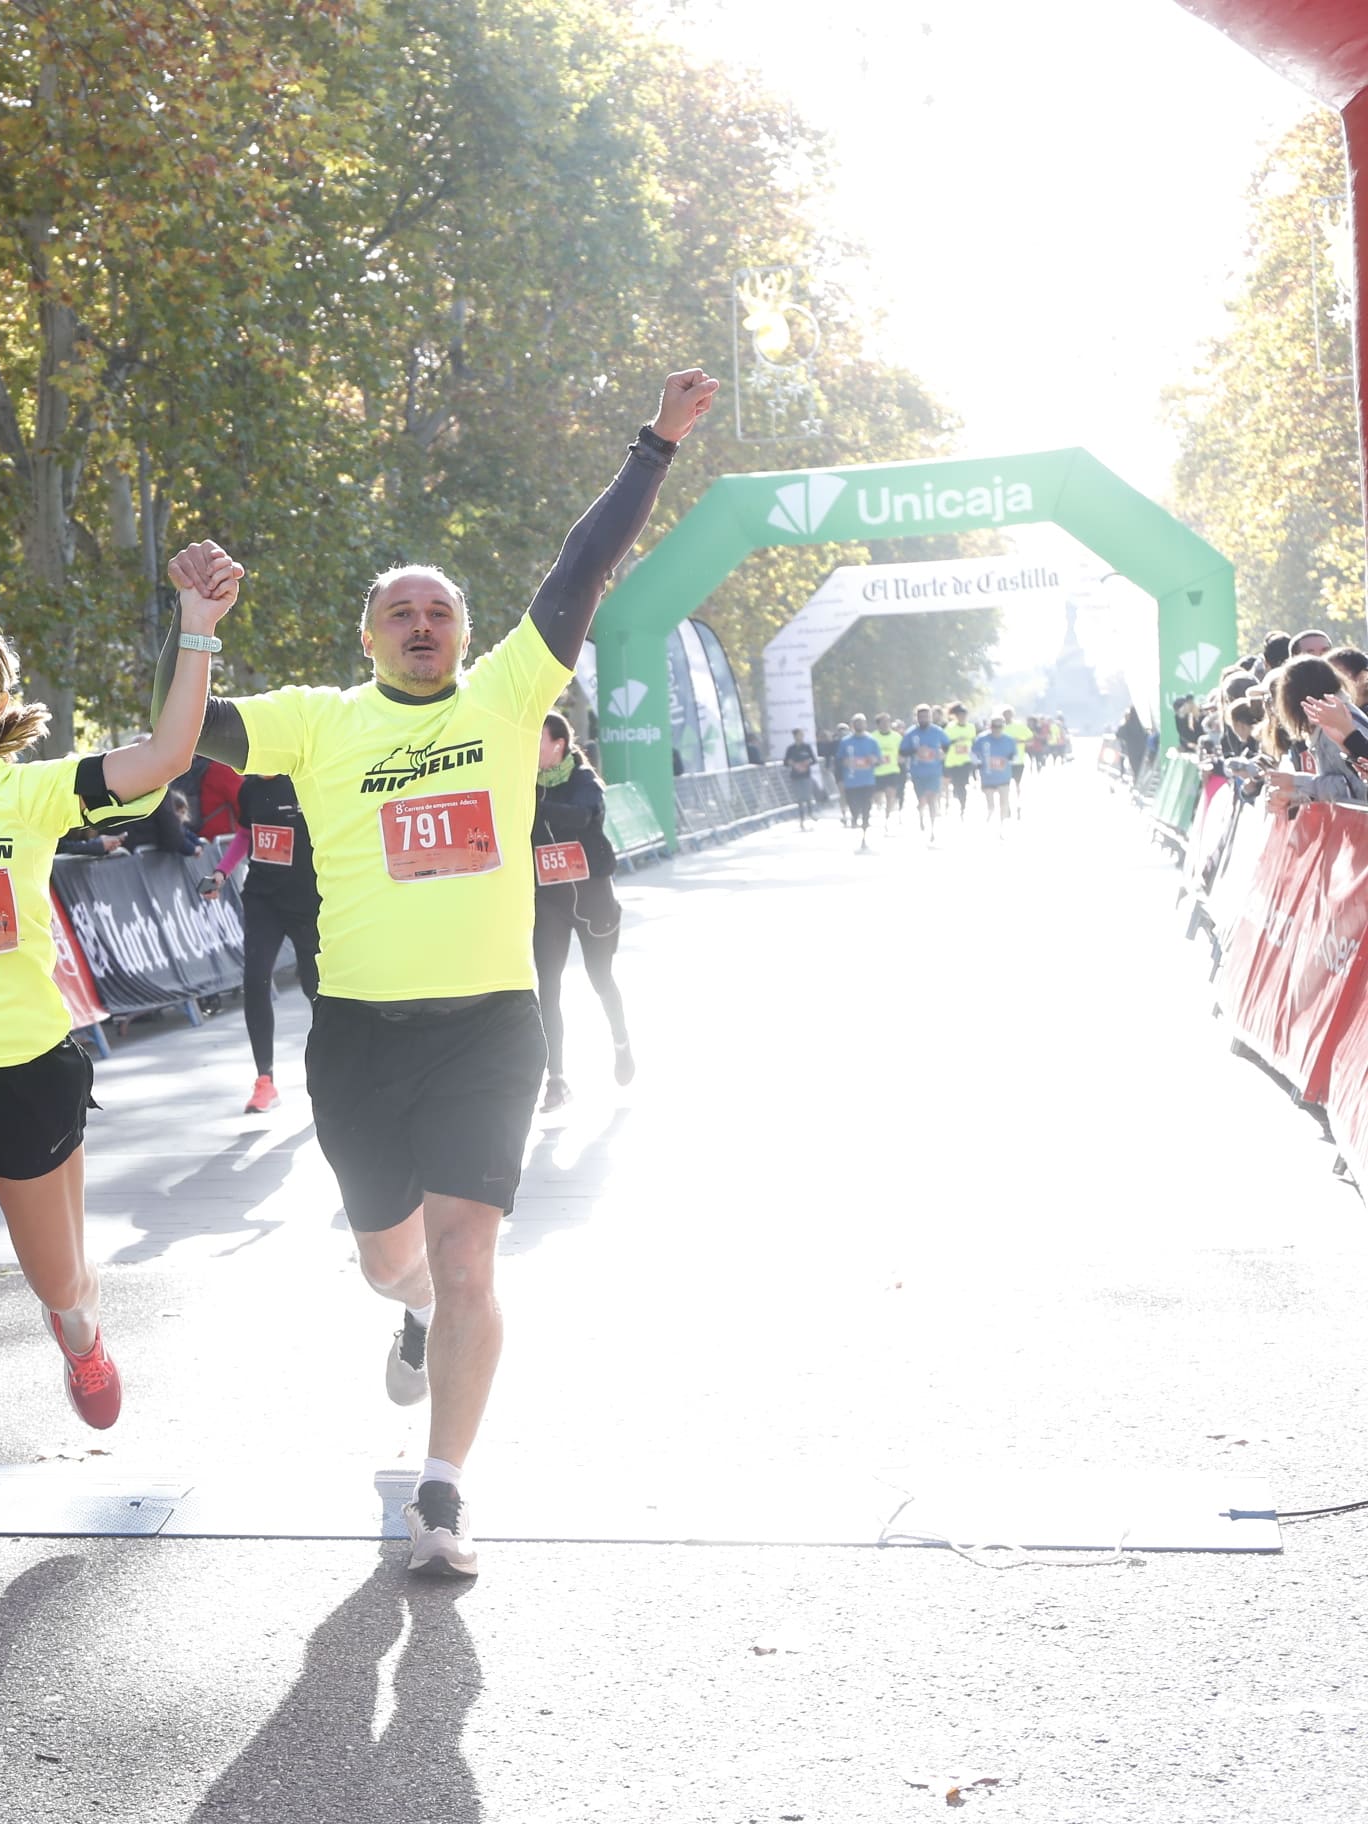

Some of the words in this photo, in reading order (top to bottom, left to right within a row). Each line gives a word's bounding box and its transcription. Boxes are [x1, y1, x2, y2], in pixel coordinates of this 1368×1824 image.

[857, 475, 1033, 525] Unicaja
[894, 576, 948, 600] Norte
[952, 576, 973, 596] de
[977, 567, 1060, 594] Castilla
[601, 723, 661, 745] Unicaja
[258, 832, 278, 849] 657
[395, 810, 453, 851] 791
[541, 851, 567, 870] 655
